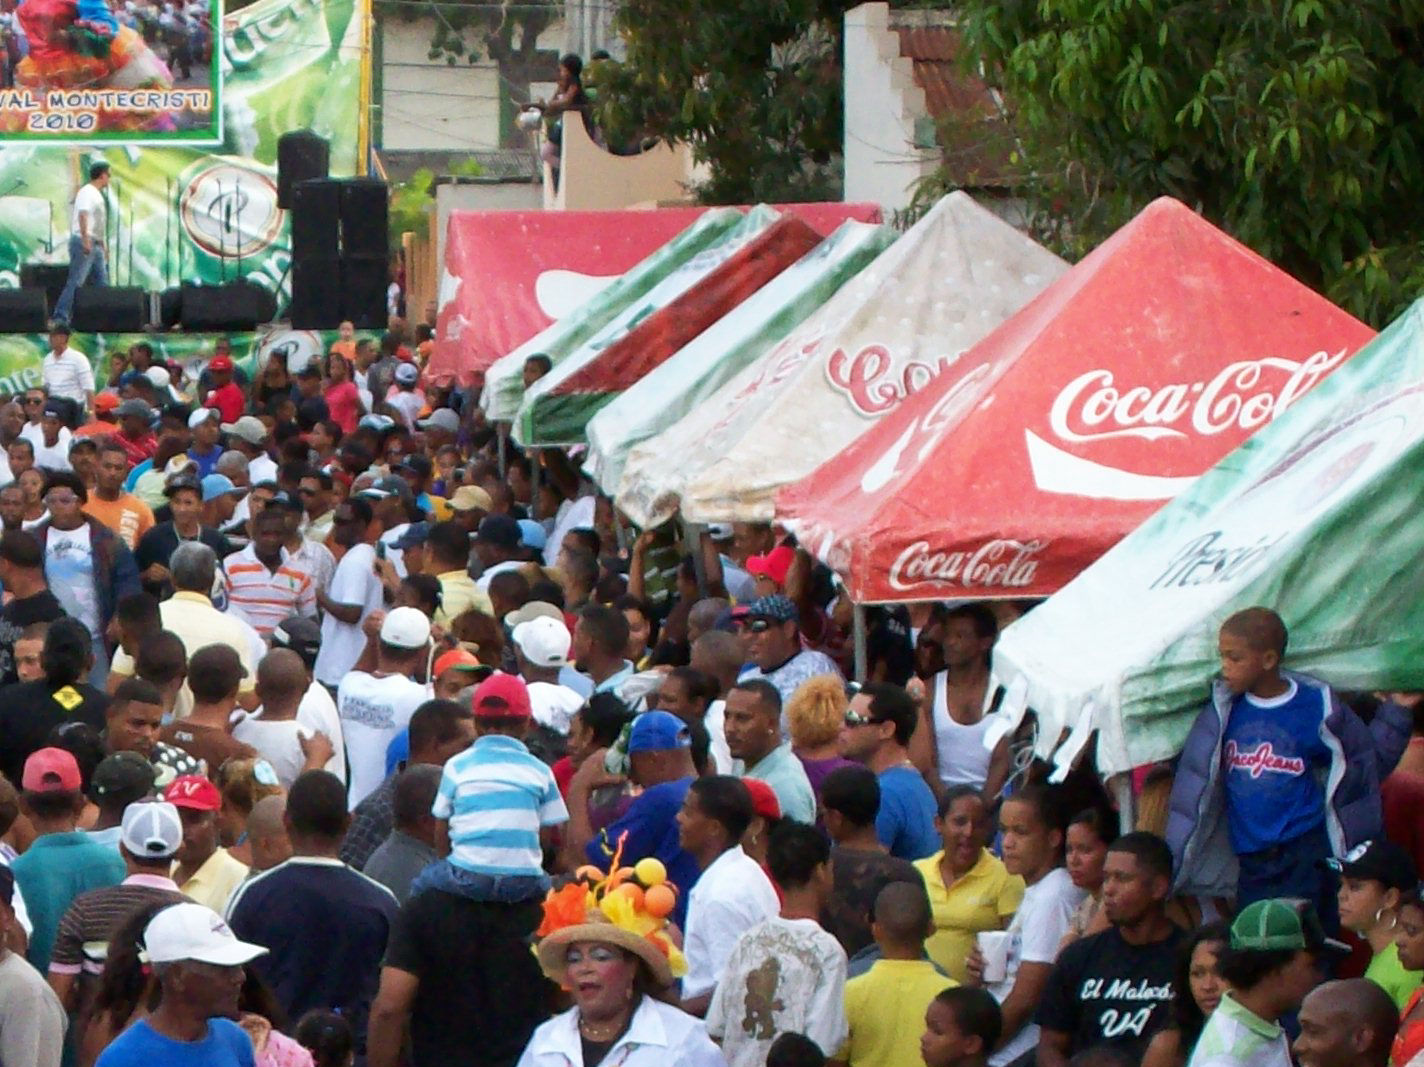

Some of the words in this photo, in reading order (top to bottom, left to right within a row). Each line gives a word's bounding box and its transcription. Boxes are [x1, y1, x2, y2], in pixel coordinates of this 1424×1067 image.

[49, 90, 211, 109] MONTECRISTI
[29, 113, 95, 131] 2010
[889, 538, 1050, 592] Coca-Cola
[1081, 978, 1104, 1000] El
